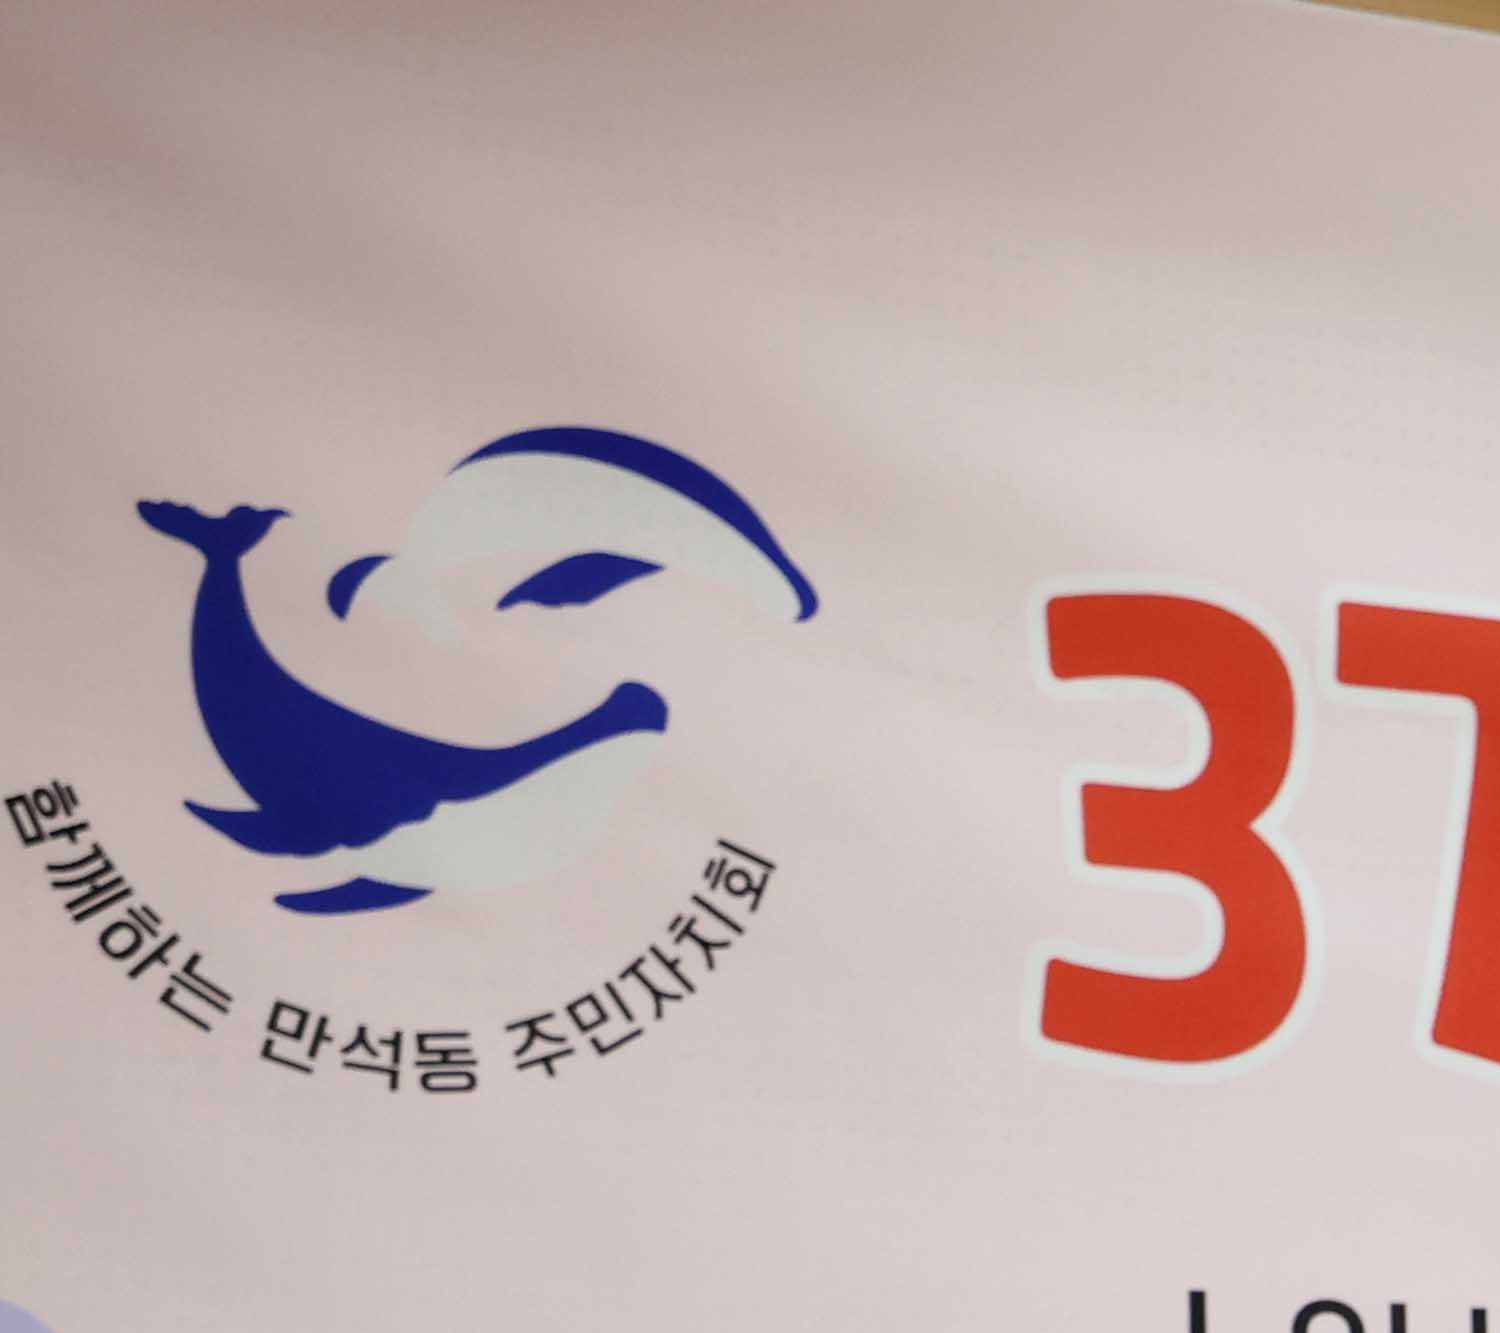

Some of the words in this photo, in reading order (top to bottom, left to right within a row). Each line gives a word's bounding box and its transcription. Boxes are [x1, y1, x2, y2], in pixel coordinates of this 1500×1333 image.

[4, 780, 233, 1031] 함께하는
[259, 1000, 478, 1093] 만석동
[505, 838, 777, 1077] 주민자치회
